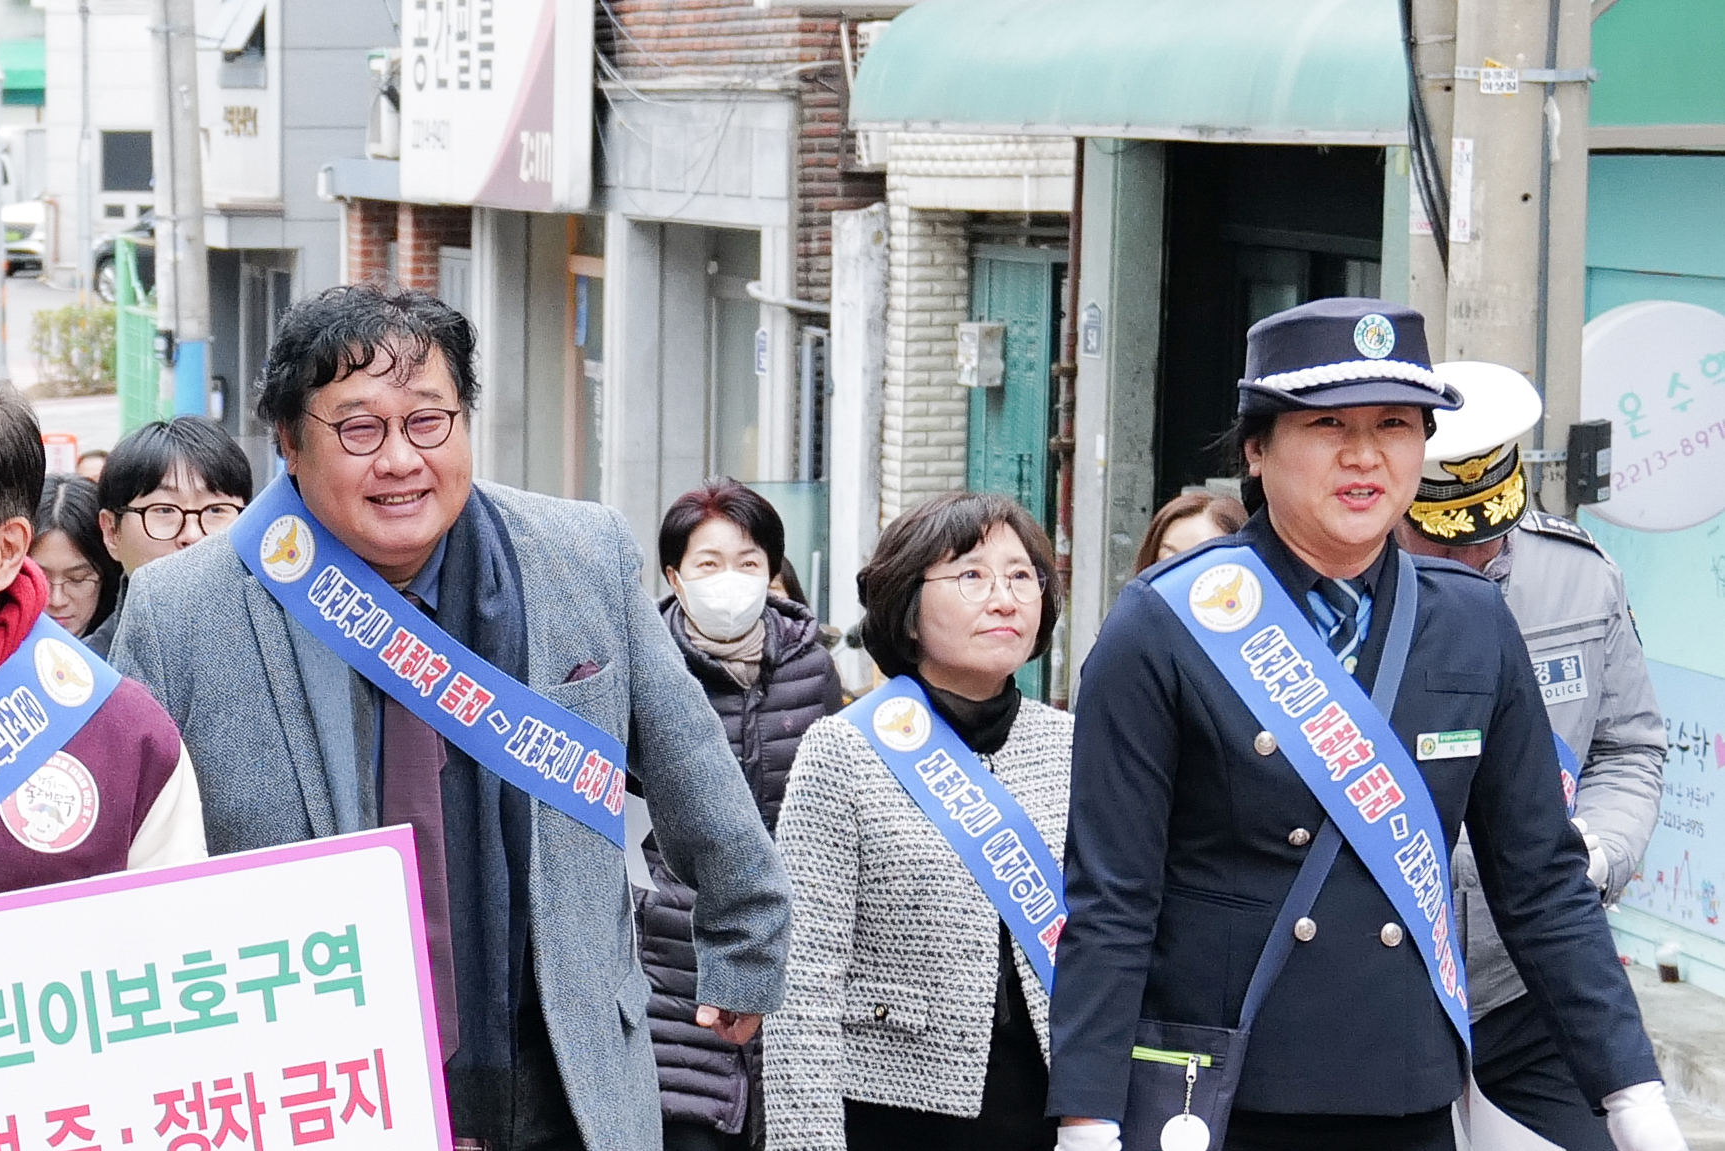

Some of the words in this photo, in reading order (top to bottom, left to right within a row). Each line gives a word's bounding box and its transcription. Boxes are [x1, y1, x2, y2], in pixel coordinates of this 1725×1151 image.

[308, 566, 393, 648] 운전자는
[378, 627, 452, 697] 보행자
[504, 716, 584, 783] 보행자는
[573, 750, 617, 804] 안전
[1534, 657, 1578, 685] 경찰
[1544, 682, 1582, 699] OLICE
[914, 749, 1002, 837] 보행자는
[984, 830, 1056, 924] 움직이는
[1240, 625, 1328, 718] 운전자는
[1300, 701, 1376, 781] 보행자
[1394, 829, 1443, 922] 보행자는
[280, 1048, 394, 1147] 금지
